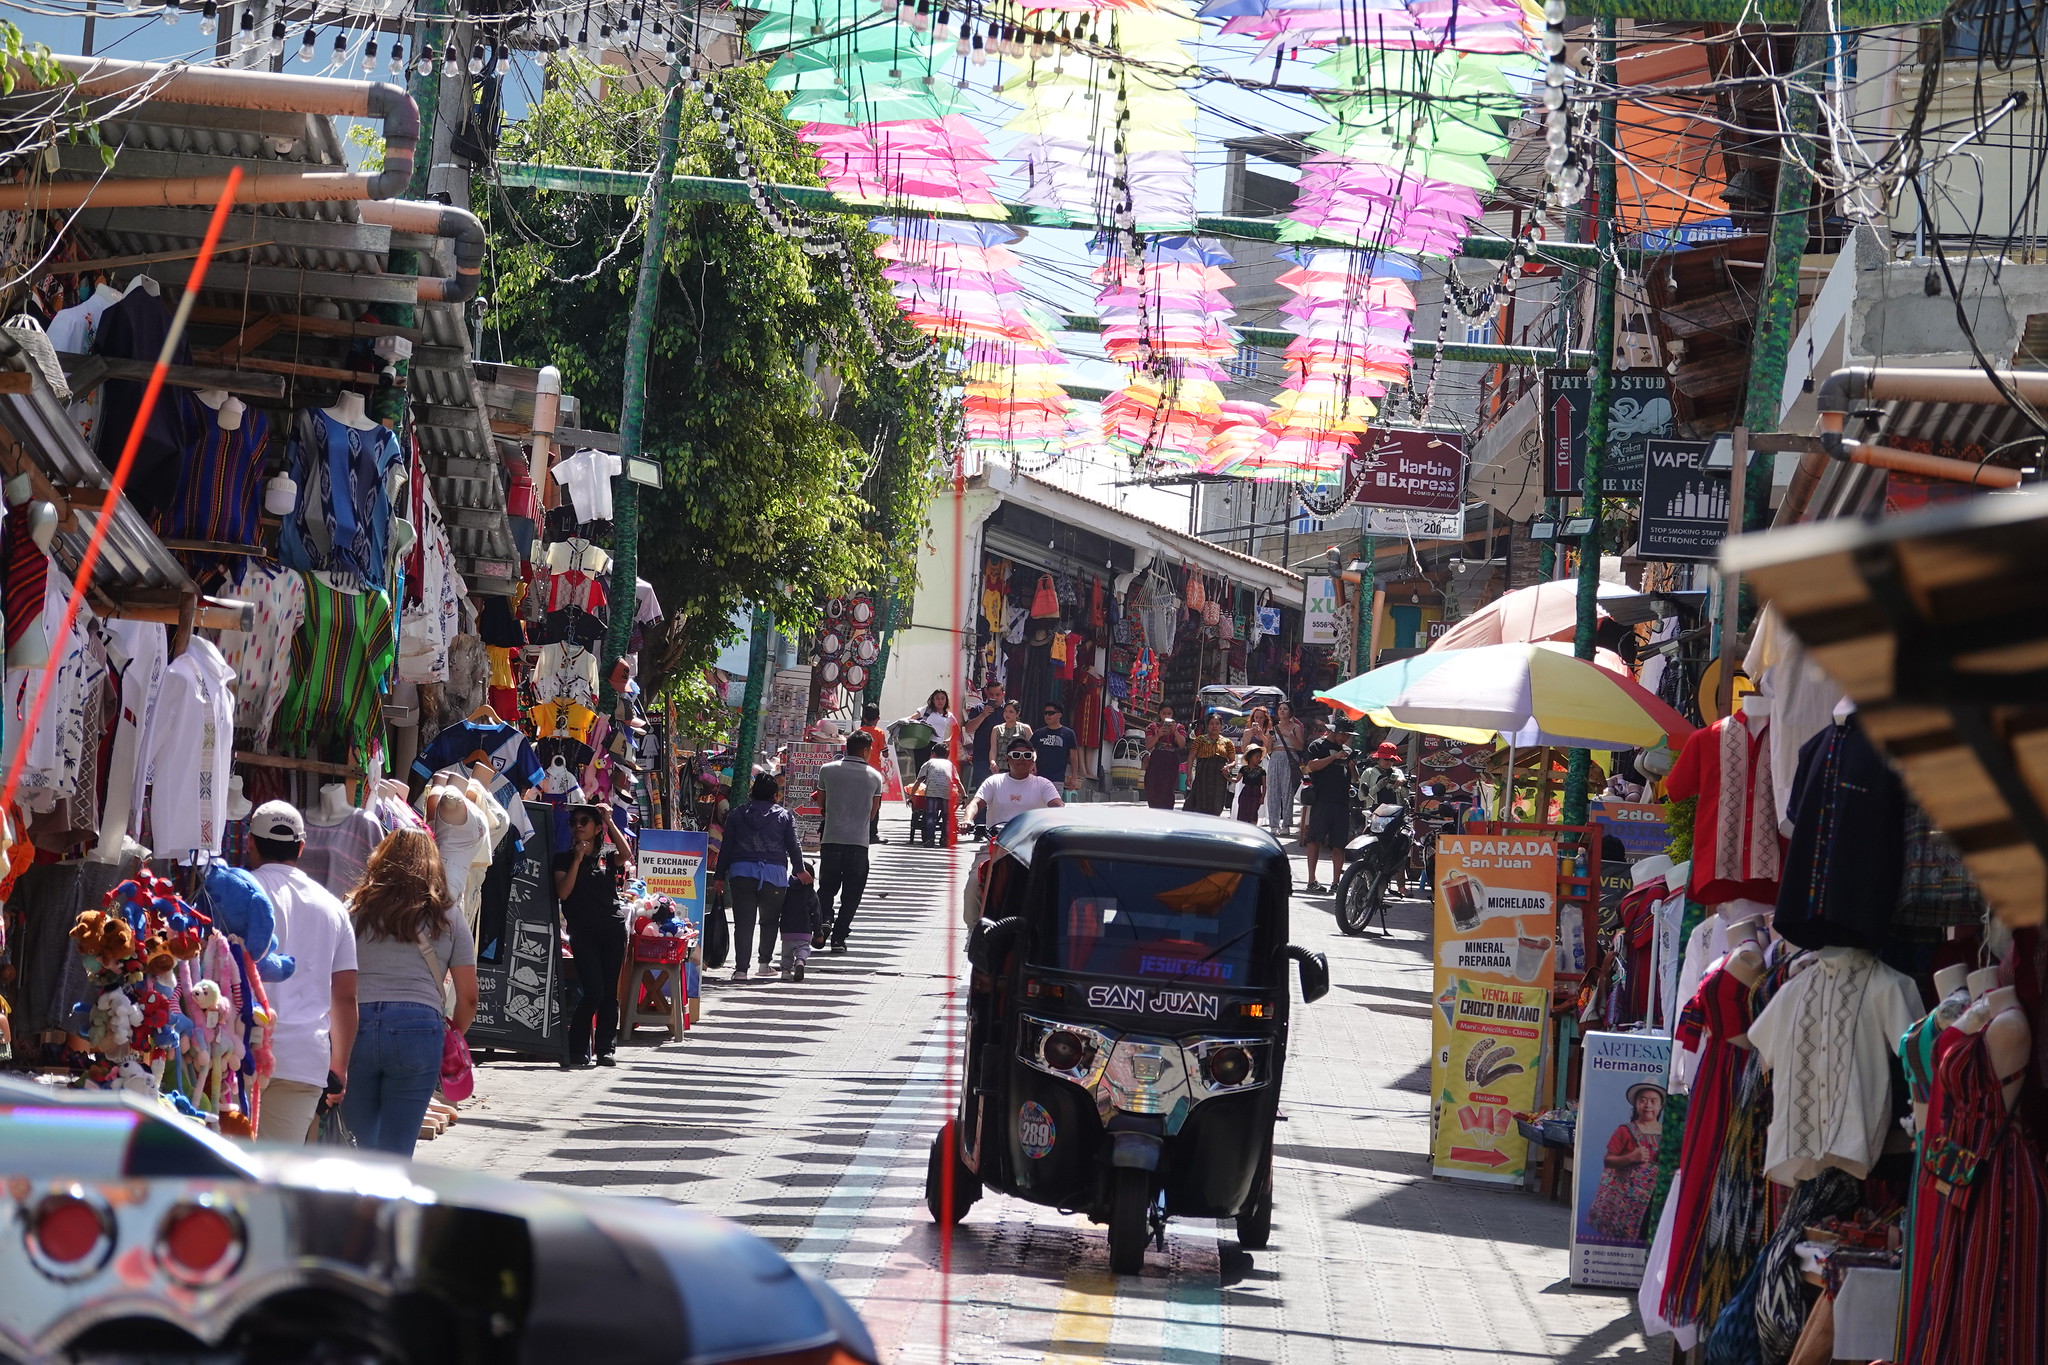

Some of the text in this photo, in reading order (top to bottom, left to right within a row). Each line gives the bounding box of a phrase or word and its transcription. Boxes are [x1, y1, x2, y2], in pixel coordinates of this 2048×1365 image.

[1400, 458, 1452, 476] Harbin
[1389, 472, 1455, 494] Express
[1668, 528, 1700, 536] SMOKING
[1650, 535, 1698, 544] ELECTRONIC
[1617, 809, 1660, 822] 2do.
[1439, 840, 1554, 856] LA PARADA
[642, 856, 698, 866] WE EXCHANGE
[1462, 856, 1532, 868] San Juan
[652, 866, 687, 875] DOLLARS
[648, 878, 692, 886] CAMBIAMOS
[652, 886, 685, 894] DOLARES
[1488, 898, 1545, 908] MICHELADAS
[1465, 942, 1504, 953] MINERAL
[1140, 955, 1233, 979] JESUCRISTO
[1458, 956, 1511, 967] PREPARADA
[1482, 988, 1524, 1004] VENTA DE
[1088, 985, 1218, 1020] SAN JUAN
[1460, 1000, 1540, 1022] CHOCO BANANO
[1594, 1057, 1664, 1074] Hermanos
[1476, 1094, 1502, 1102] Helados
[1022, 1122, 1049, 1146] 289
